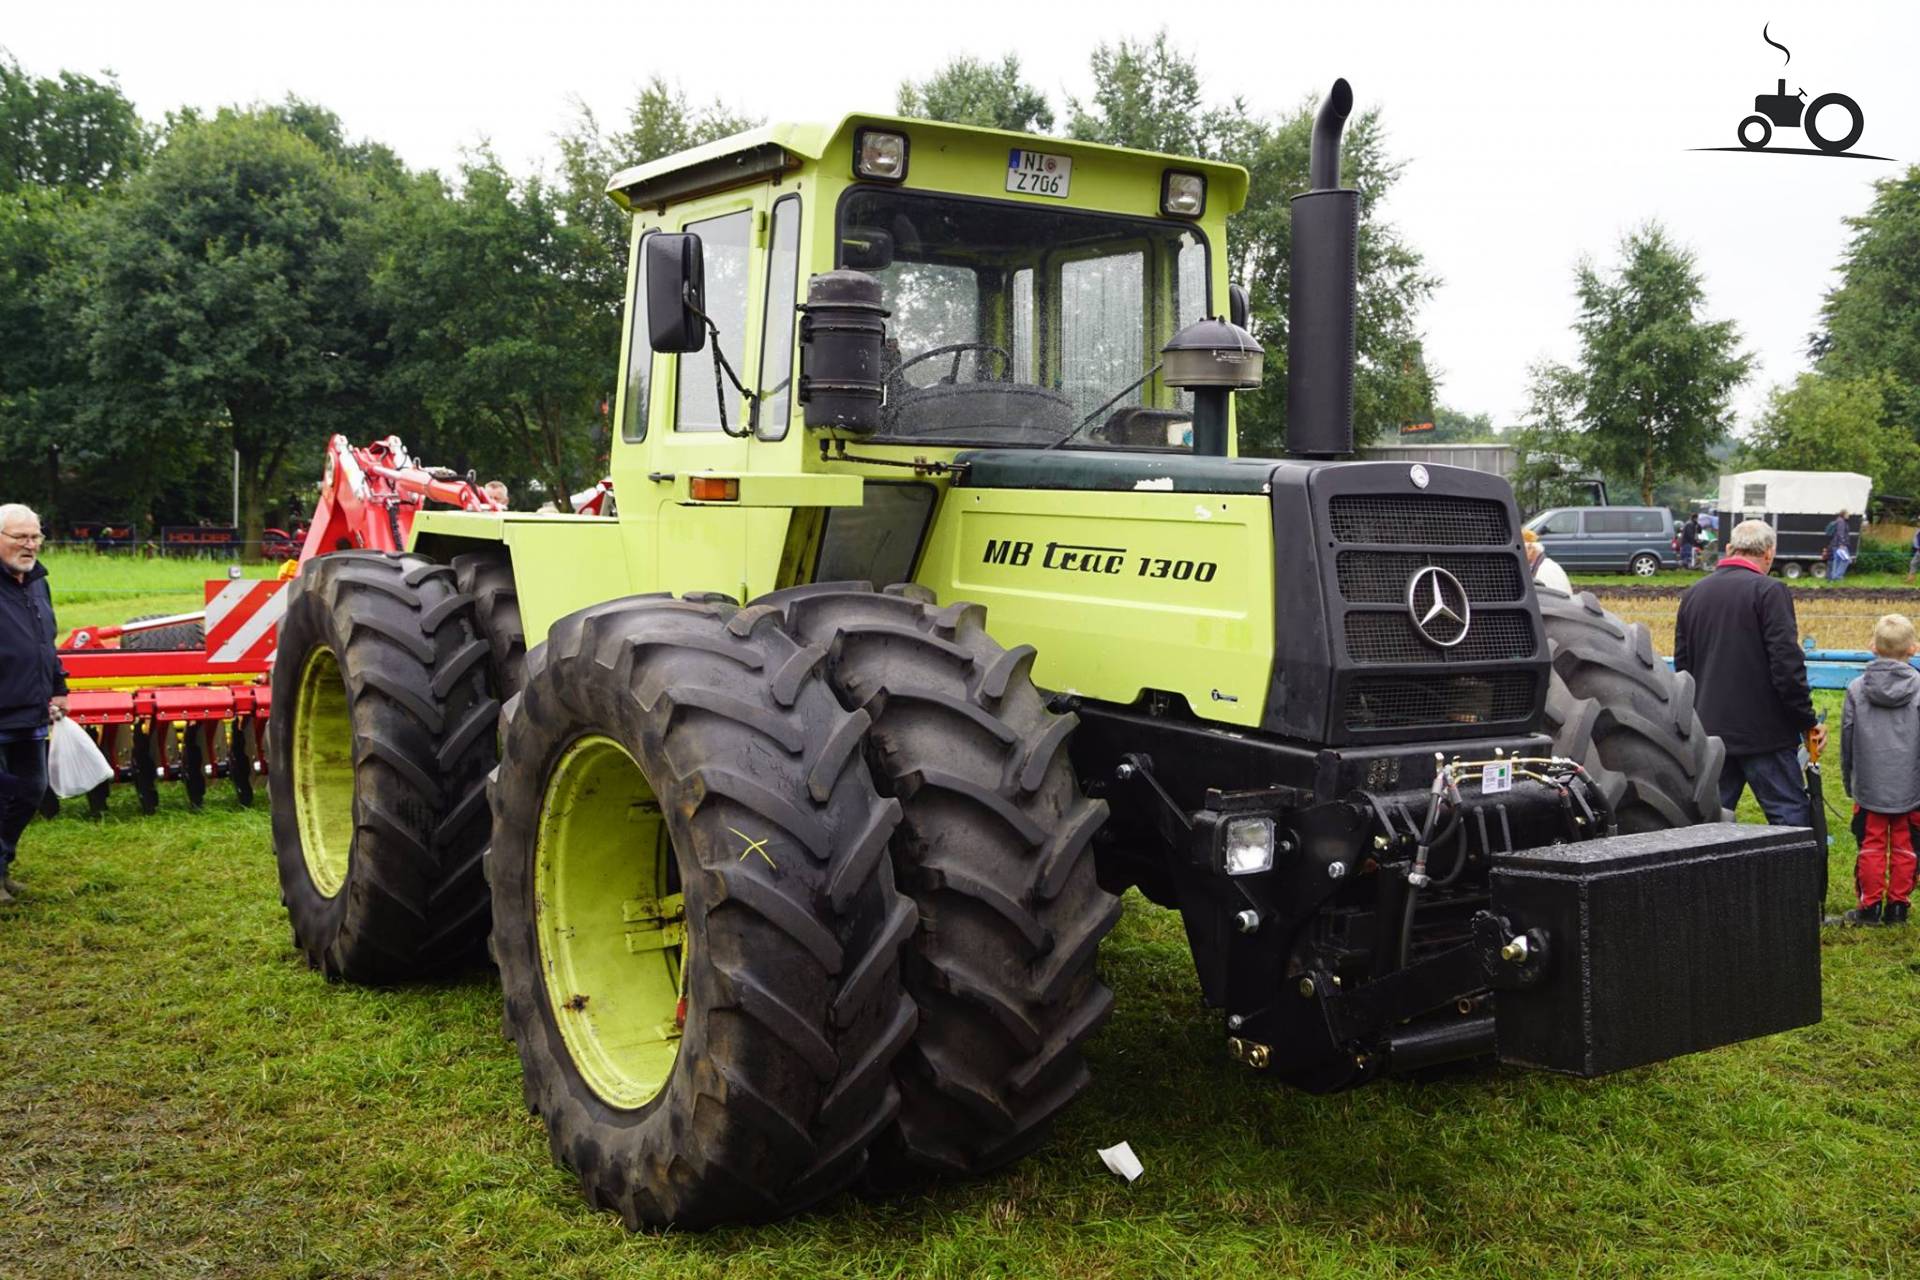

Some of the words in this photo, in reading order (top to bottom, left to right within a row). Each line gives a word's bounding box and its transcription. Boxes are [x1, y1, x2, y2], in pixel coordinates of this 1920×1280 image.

[1024, 153, 1044, 171] NI
[1017, 172, 1027, 190] Z
[982, 539, 1033, 566] MB
[1042, 542, 1127, 575] trac
[1137, 557, 1217, 583] 1300
